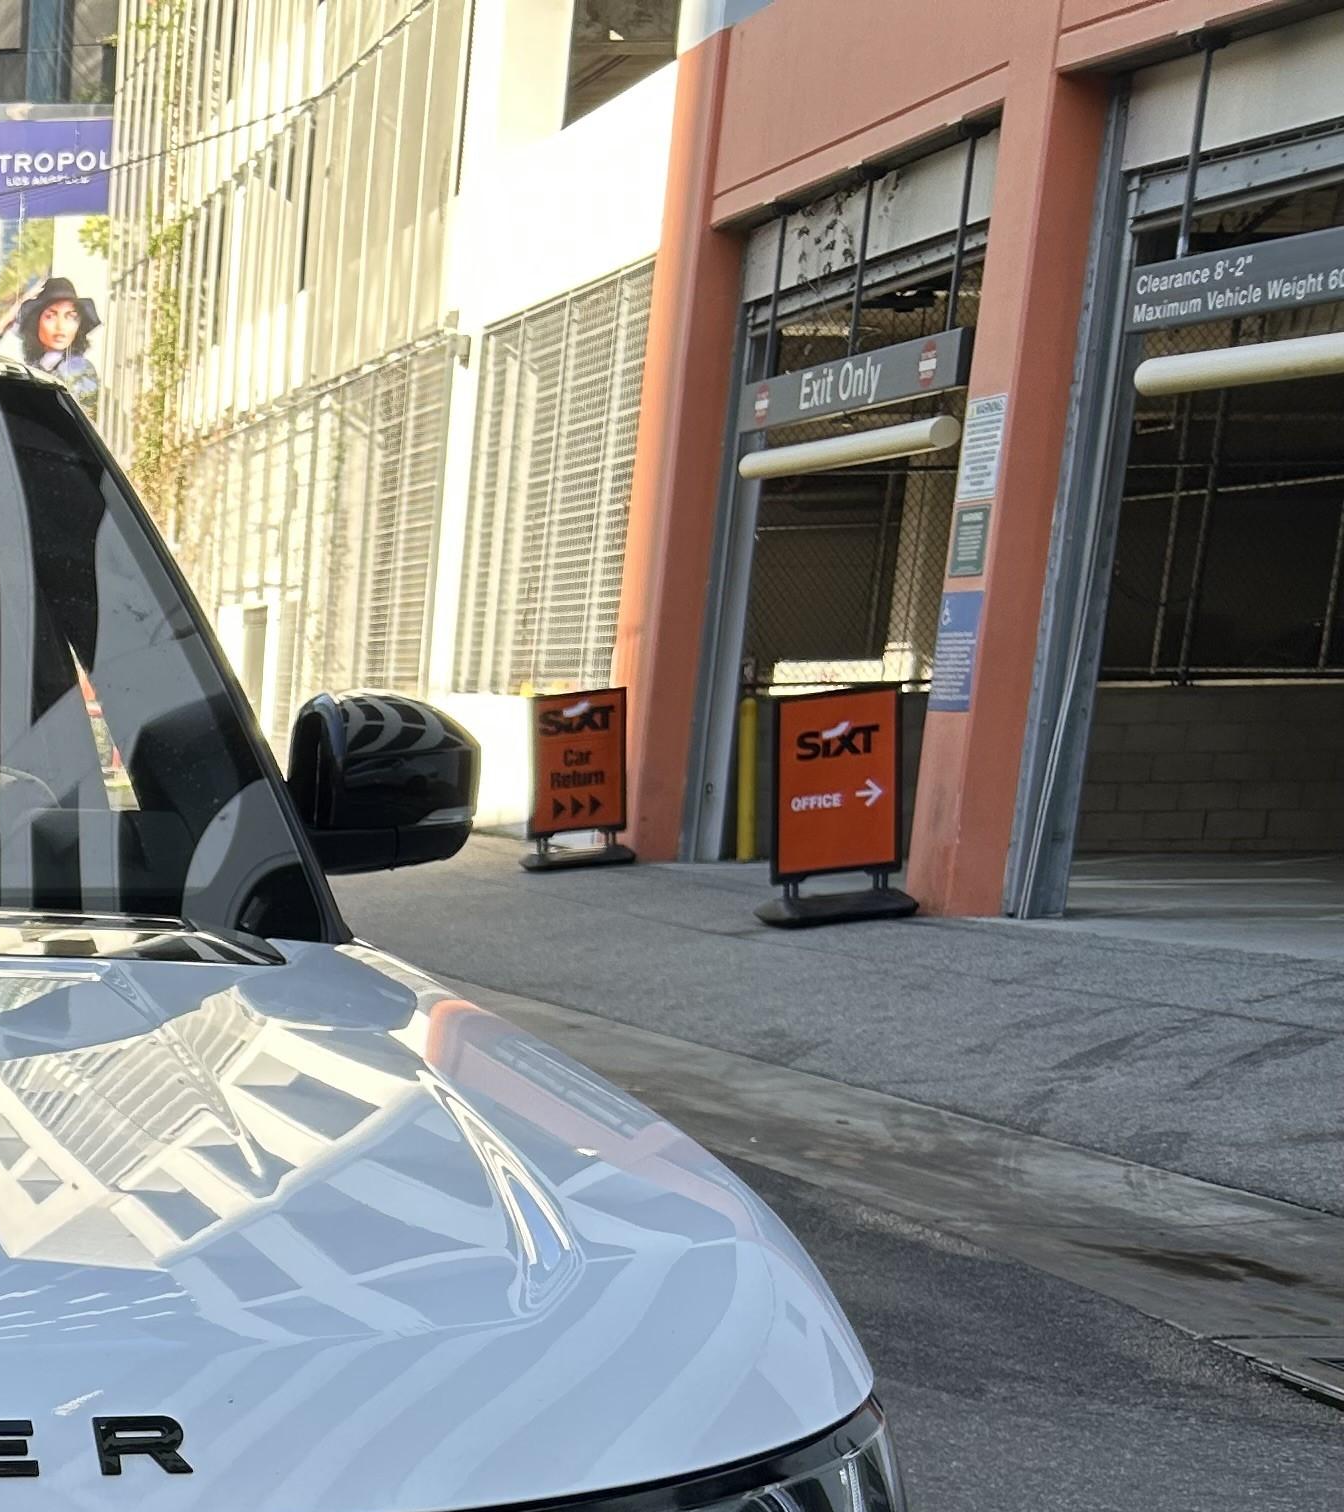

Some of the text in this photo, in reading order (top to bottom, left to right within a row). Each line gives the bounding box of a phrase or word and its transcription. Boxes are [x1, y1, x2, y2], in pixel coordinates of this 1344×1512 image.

[1136, 269, 1211, 295] Clearance
[1132, 300, 1203, 324] Maximum
[1206, 284, 1263, 312] Vehicle
[1267, 272, 1324, 300] Weight
[798, 356, 882, 410] Exit Only
[563, 747, 591, 768] Car
[550, 768, 605, 790] Return
[791, 792, 842, 811] OFFICE
